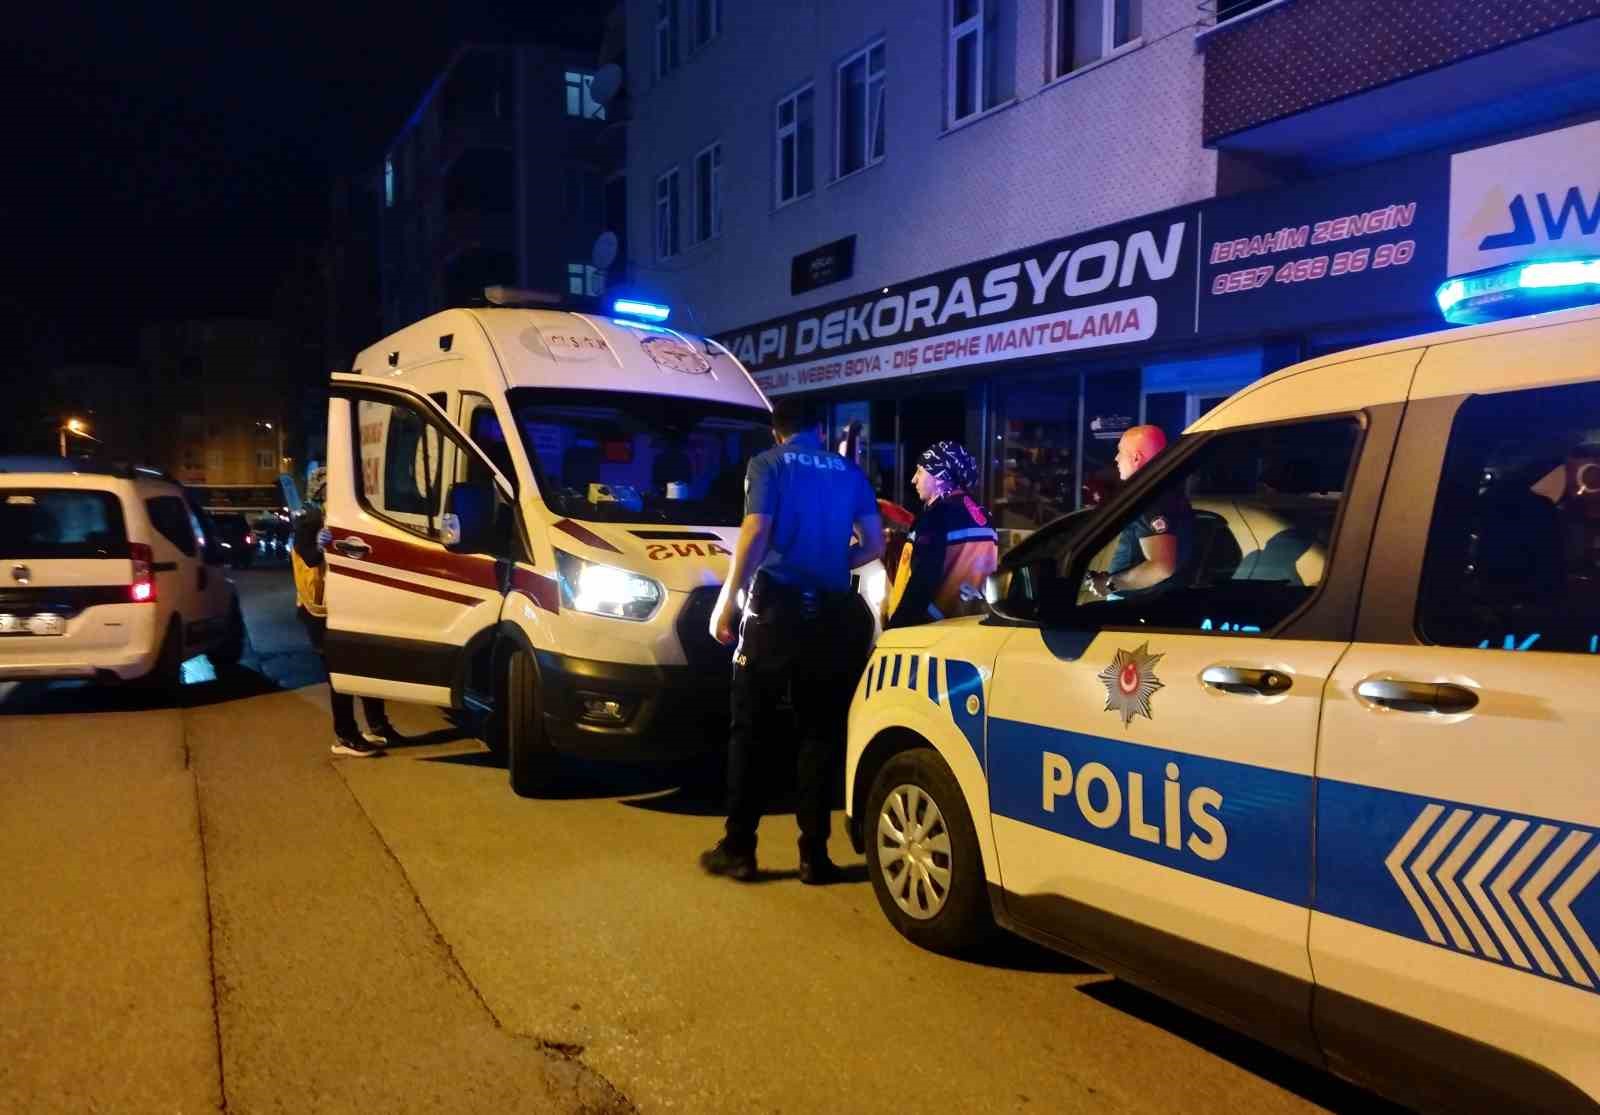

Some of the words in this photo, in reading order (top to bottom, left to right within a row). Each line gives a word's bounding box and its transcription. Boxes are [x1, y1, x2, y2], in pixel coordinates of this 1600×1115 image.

[1210, 225, 1310, 264] İBRAHİM
[1310, 202, 1416, 245] ZENGİN
[794, 222, 1186, 356] DEKORASYON
[1212, 265, 1274, 295] 0537
[923, 336, 981, 363] CEPHE
[985, 308, 1140, 354] MANTOLAMA
[1042, 751, 1228, 861] POLİS
